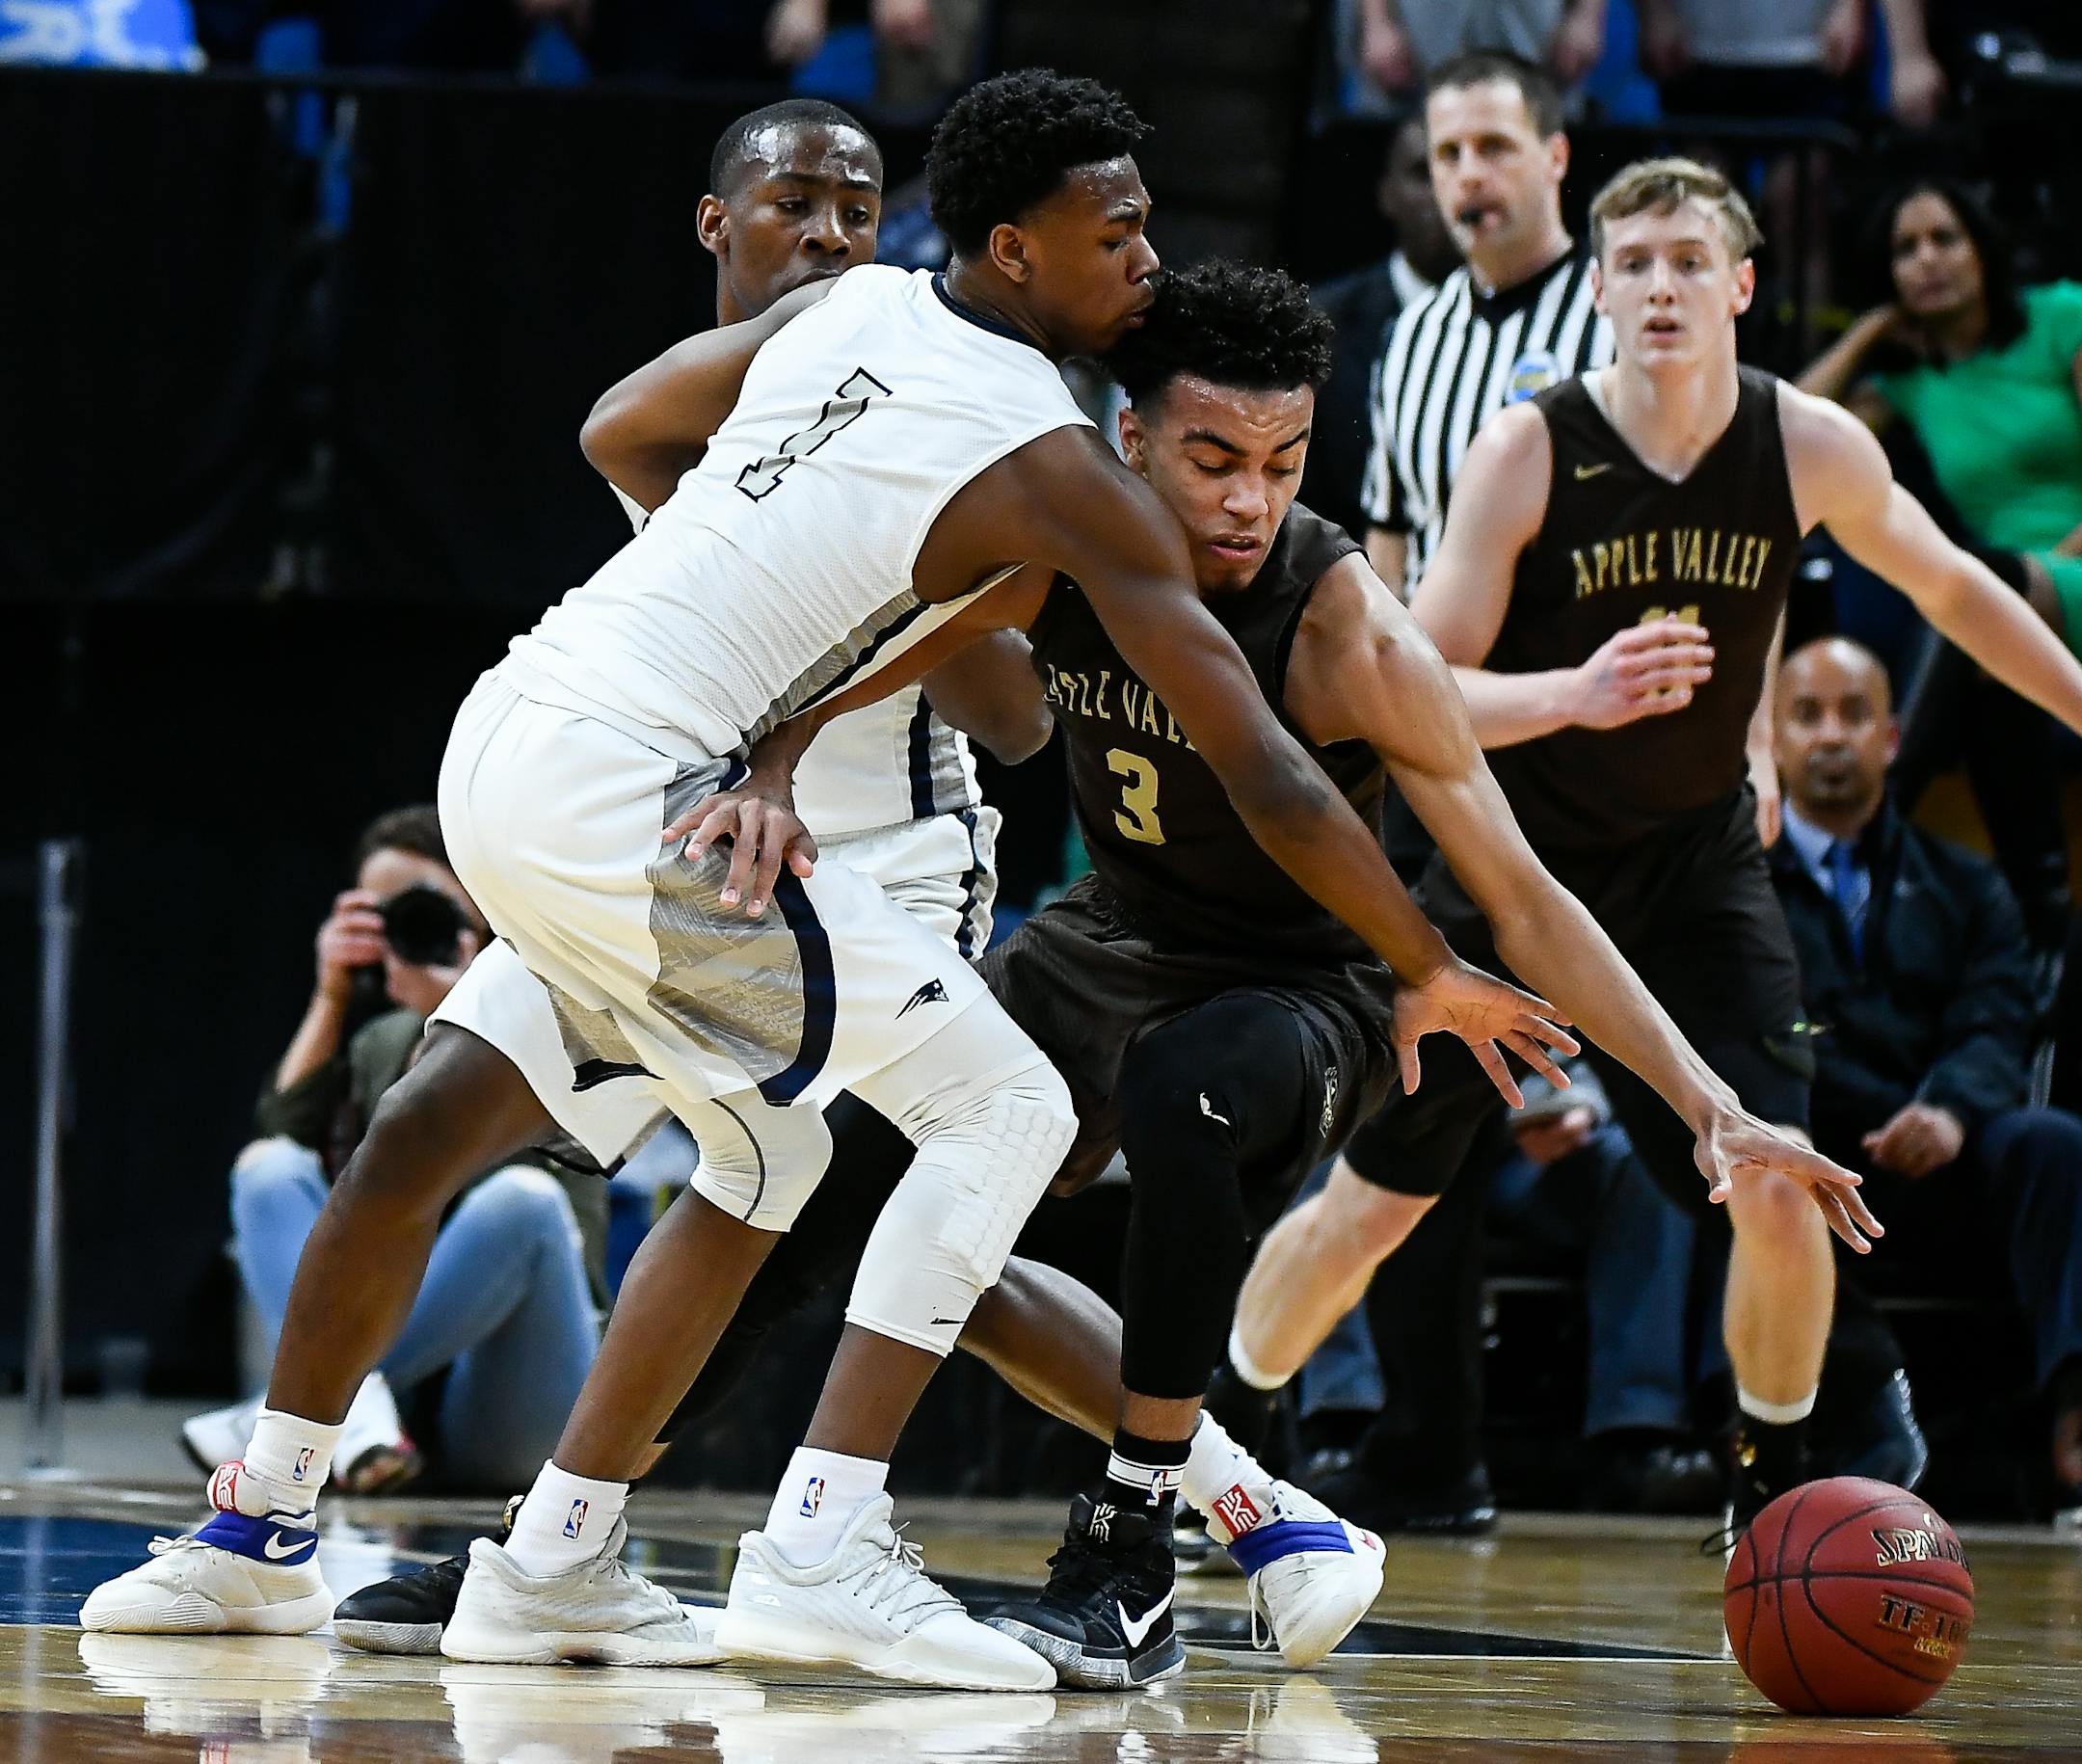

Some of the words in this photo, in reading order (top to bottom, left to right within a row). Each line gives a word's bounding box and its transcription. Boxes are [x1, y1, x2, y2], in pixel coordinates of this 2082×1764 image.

[734, 366, 894, 503] 1
[1571, 531, 1658, 599] APPLE
[1672, 528, 1772, 591] VALLEY
[1122, 680, 1196, 751] VAL
[1106, 747, 1166, 845] 3
